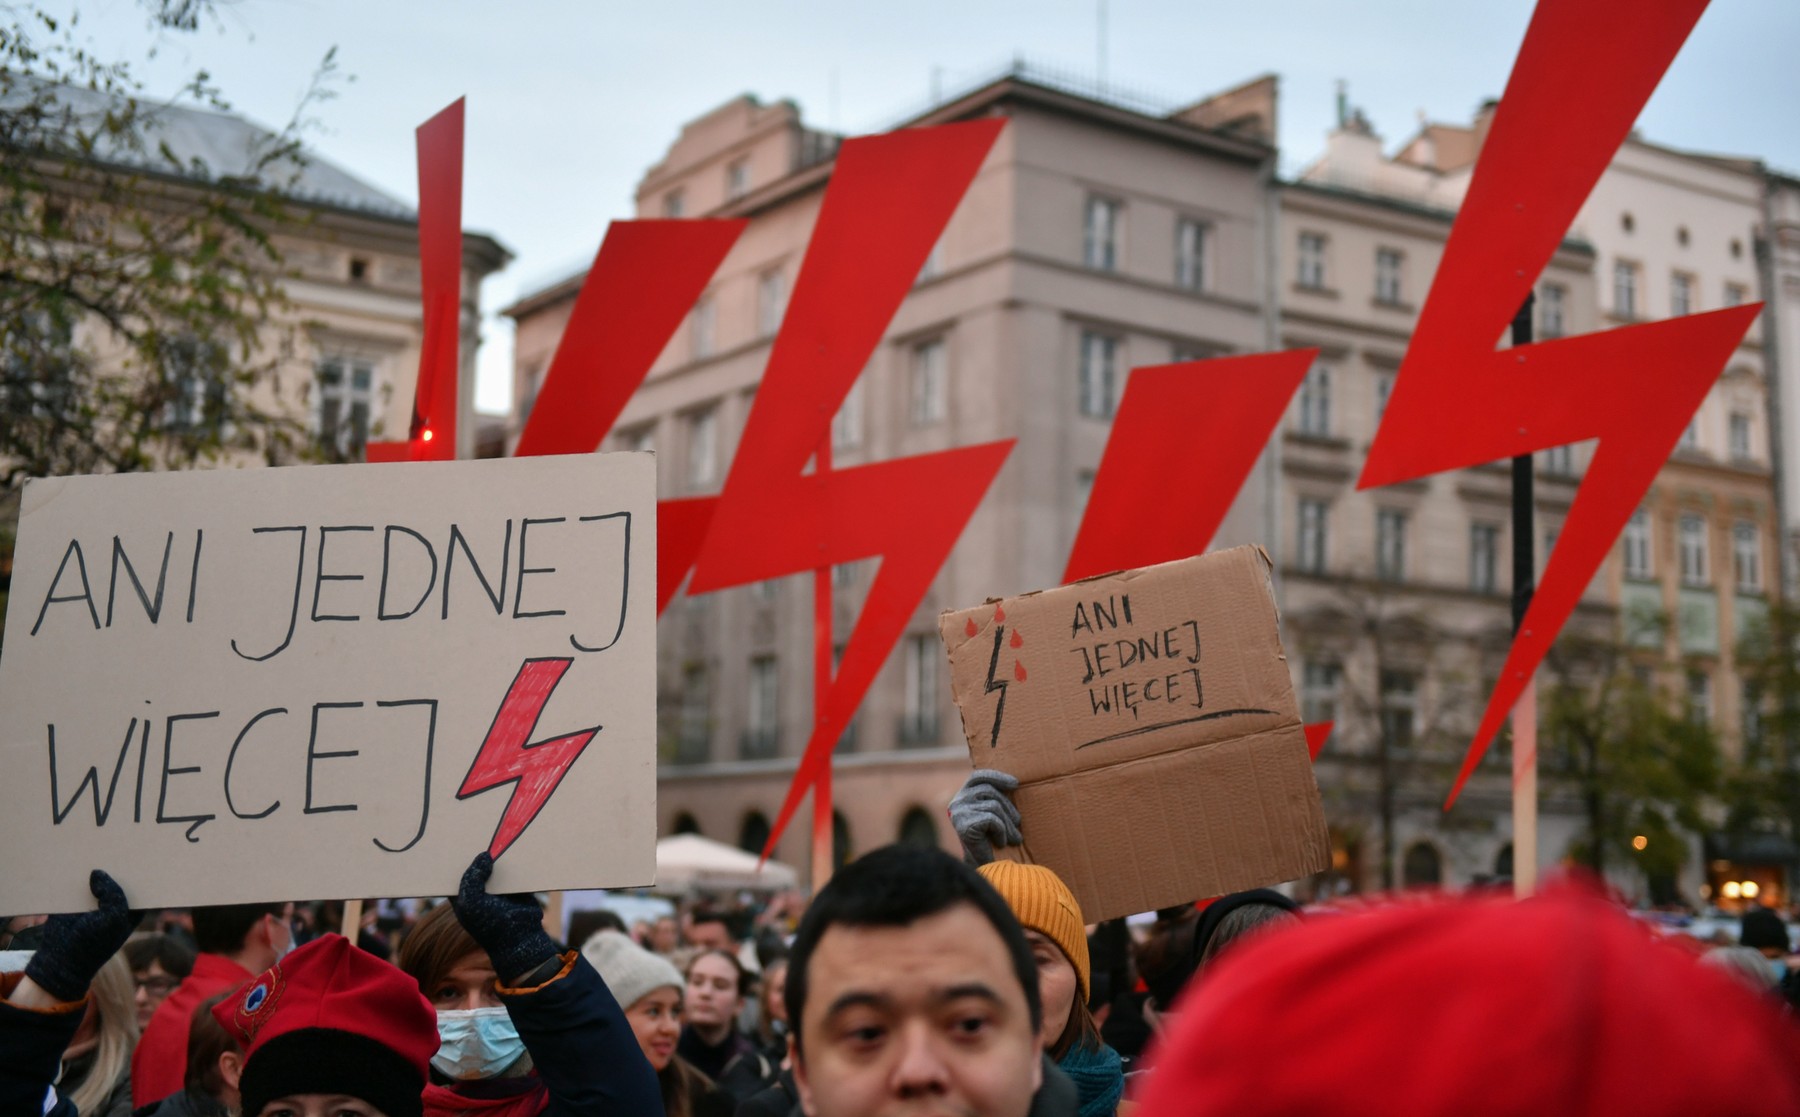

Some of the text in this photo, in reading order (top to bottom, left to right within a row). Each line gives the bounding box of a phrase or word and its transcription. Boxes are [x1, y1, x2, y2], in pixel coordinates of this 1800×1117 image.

[30, 512, 632, 661] ANI JEDNEJ
[1071, 594, 1133, 638] ANI
[1070, 620, 1201, 684] JEDNEJ
[1089, 668, 1203, 719] WIĘCEJ
